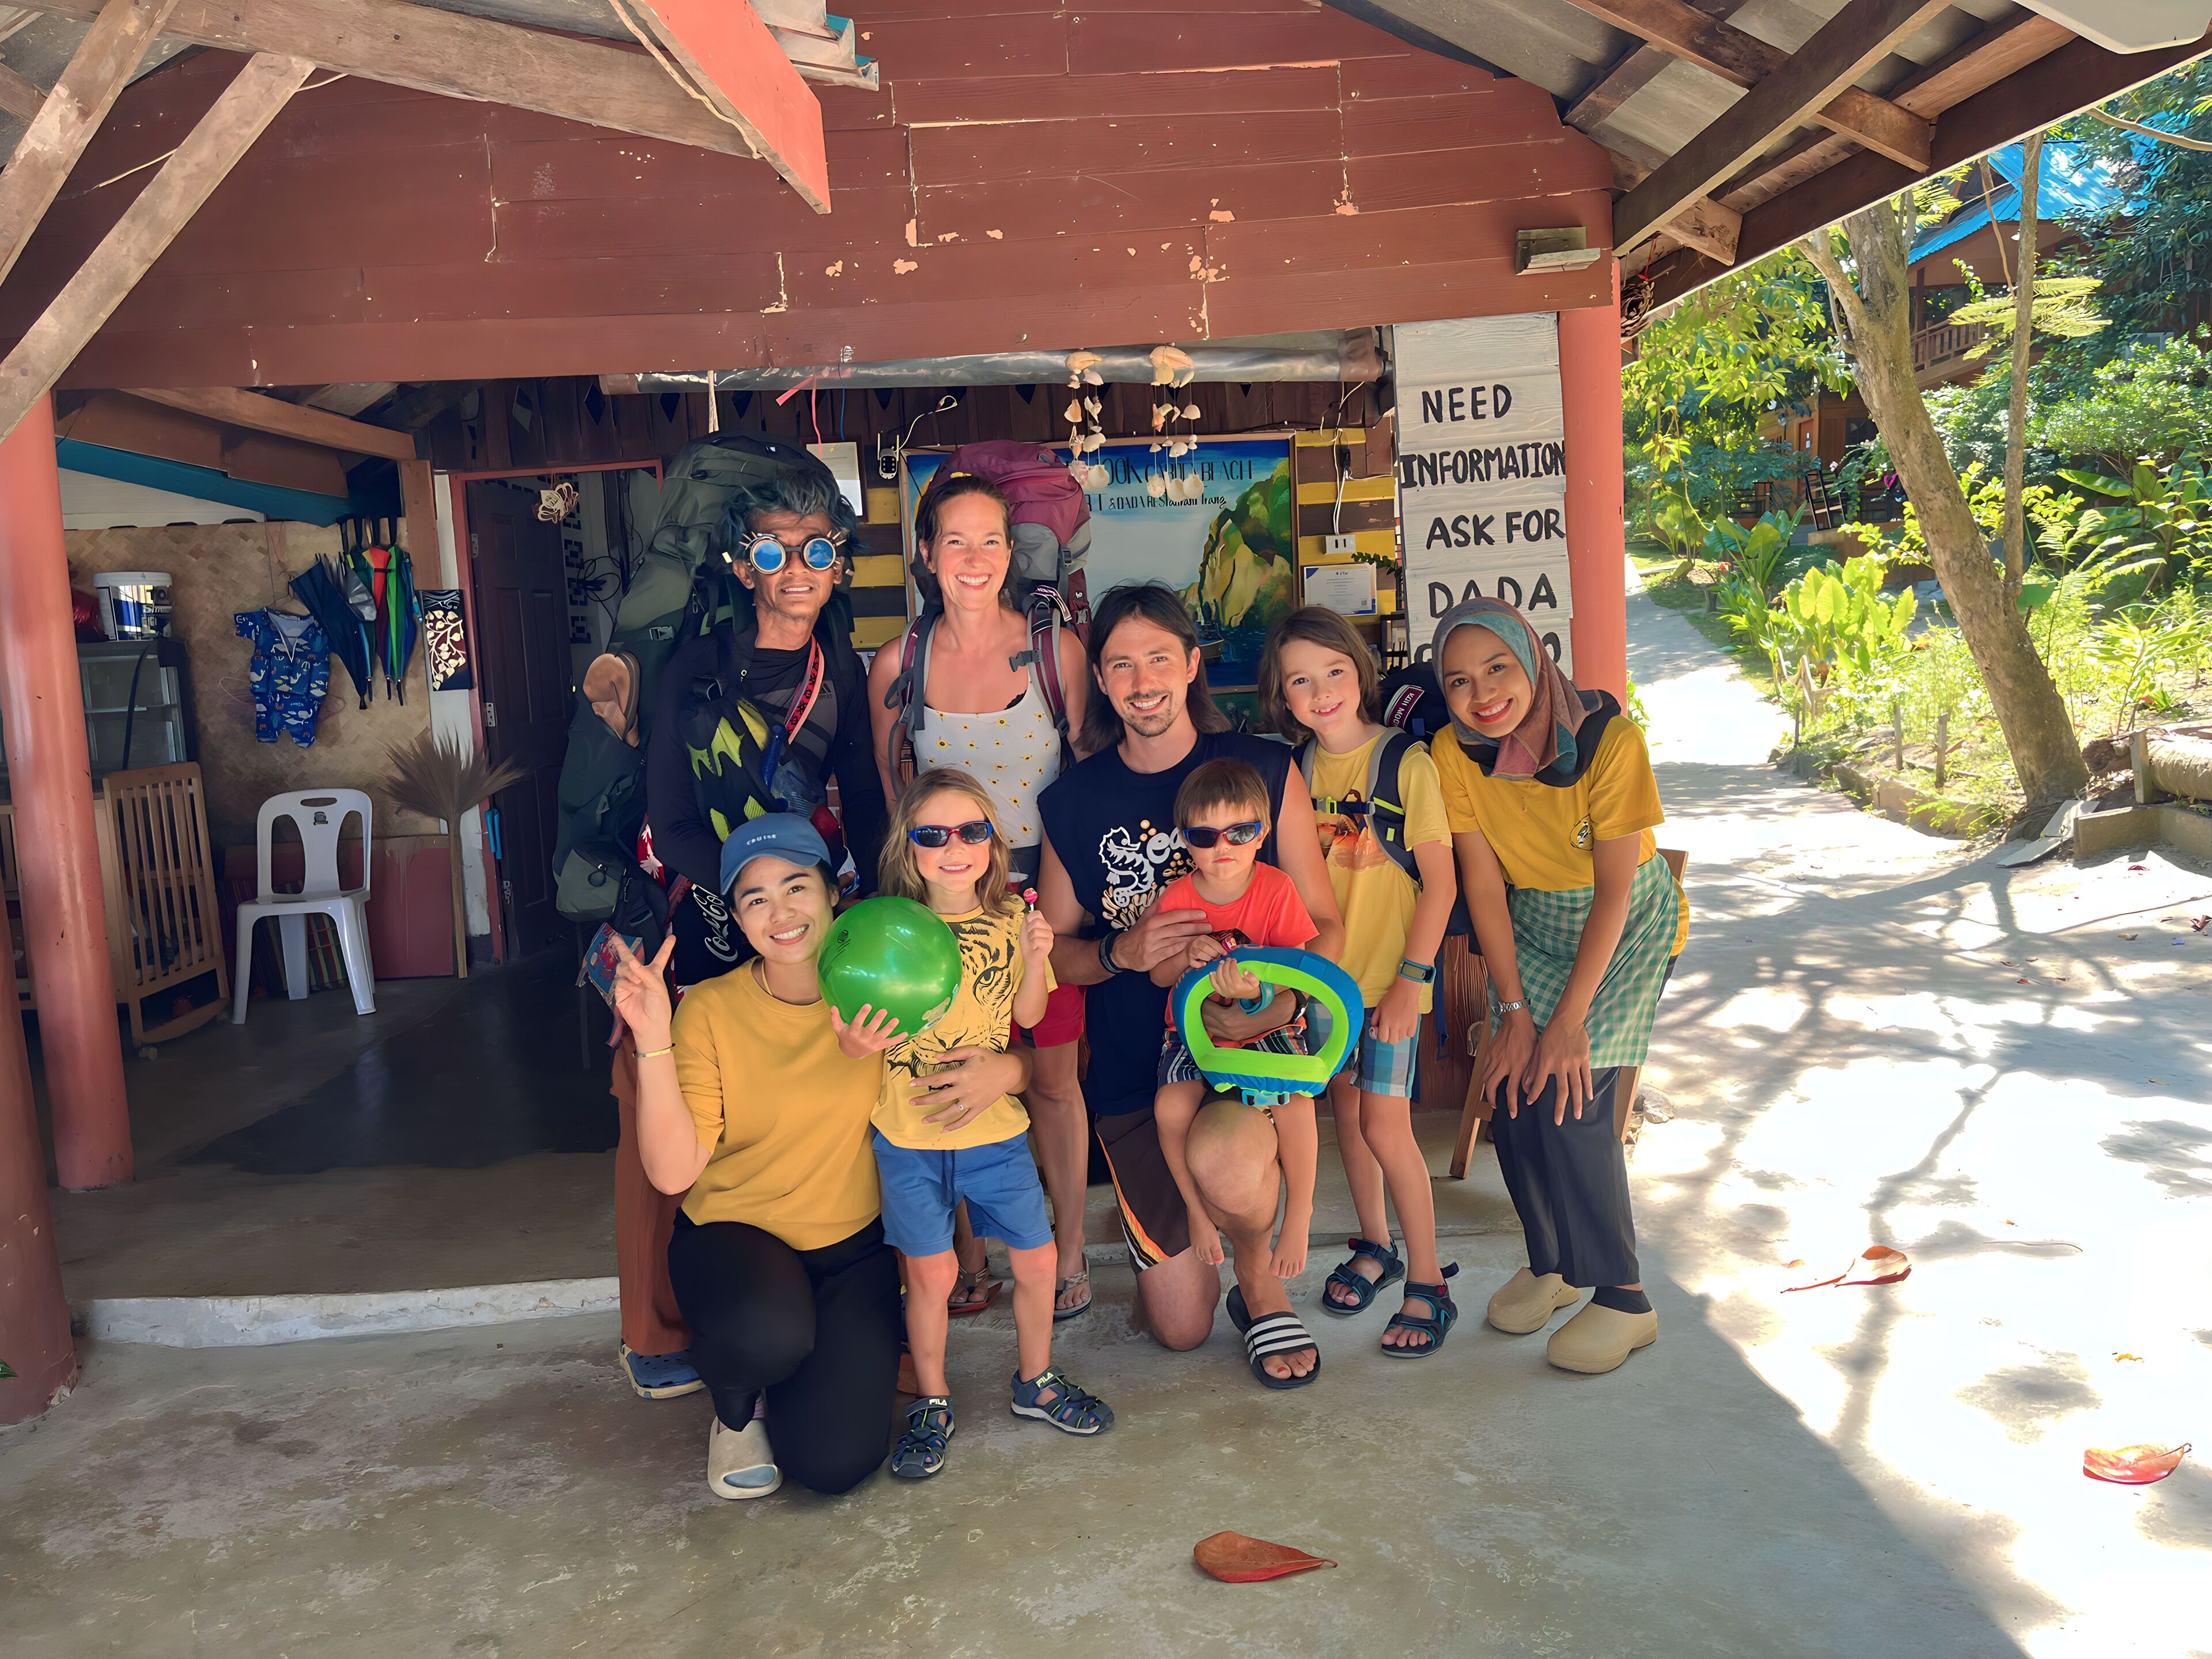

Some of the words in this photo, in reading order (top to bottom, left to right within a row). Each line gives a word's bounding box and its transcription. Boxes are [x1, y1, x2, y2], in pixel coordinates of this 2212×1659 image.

[1422, 384, 1512, 424] NEED
[1097, 457, 1142, 486] OOK
[1201, 460, 1252, 482] BEACH
[1400, 440, 1566, 488] INFORMATION
[1426, 514, 1495, 550] ASK
[1506, 508, 1566, 544] FOR
[1035, 1372, 1054, 1388] FILA
[929, 1398, 948, 1407] FILA
